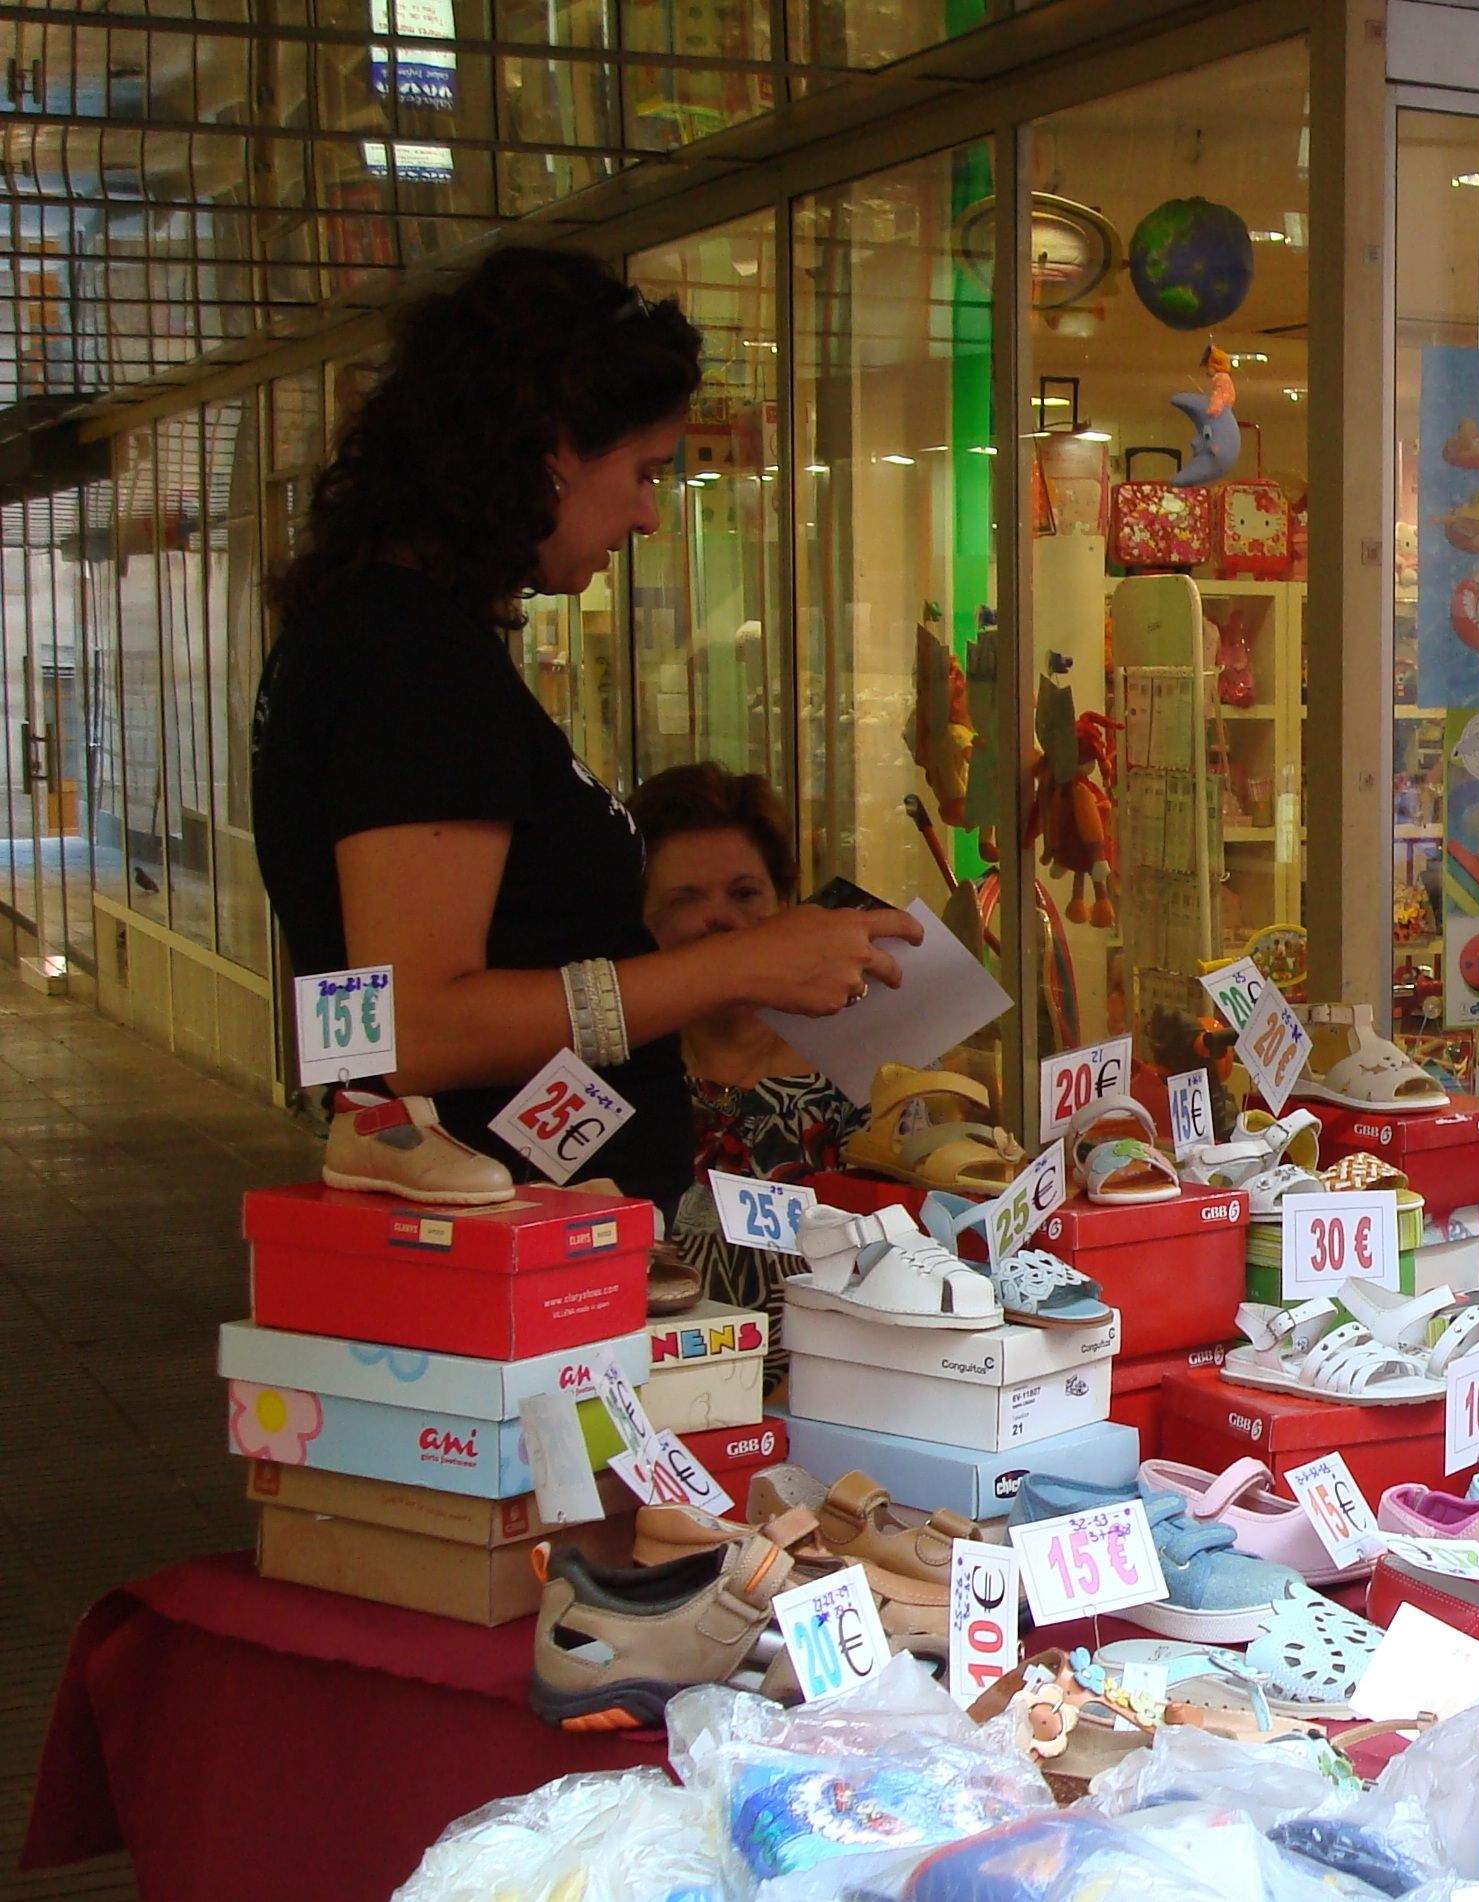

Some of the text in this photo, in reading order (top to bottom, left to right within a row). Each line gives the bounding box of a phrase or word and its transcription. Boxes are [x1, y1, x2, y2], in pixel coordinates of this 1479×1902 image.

[517, 1081, 606, 1161] 25€
[1353, 1123, 1380, 1139] GBB
[1202, 1206, 1229, 1221] GBB
[651, 1322, 763, 1363] NENS
[941, 1359, 987, 1375] Conguitos
[1188, 1350, 1214, 1365] GBB
[1012, 1423, 1023, 1436] 21
[1229, 1412, 1251, 1431] GBB
[418, 1427, 479, 1458] ani
[727, 1438, 760, 1457] GBB
[967, 1565, 1006, 1689] 10€
[793, 1607, 874, 1698] 20€
